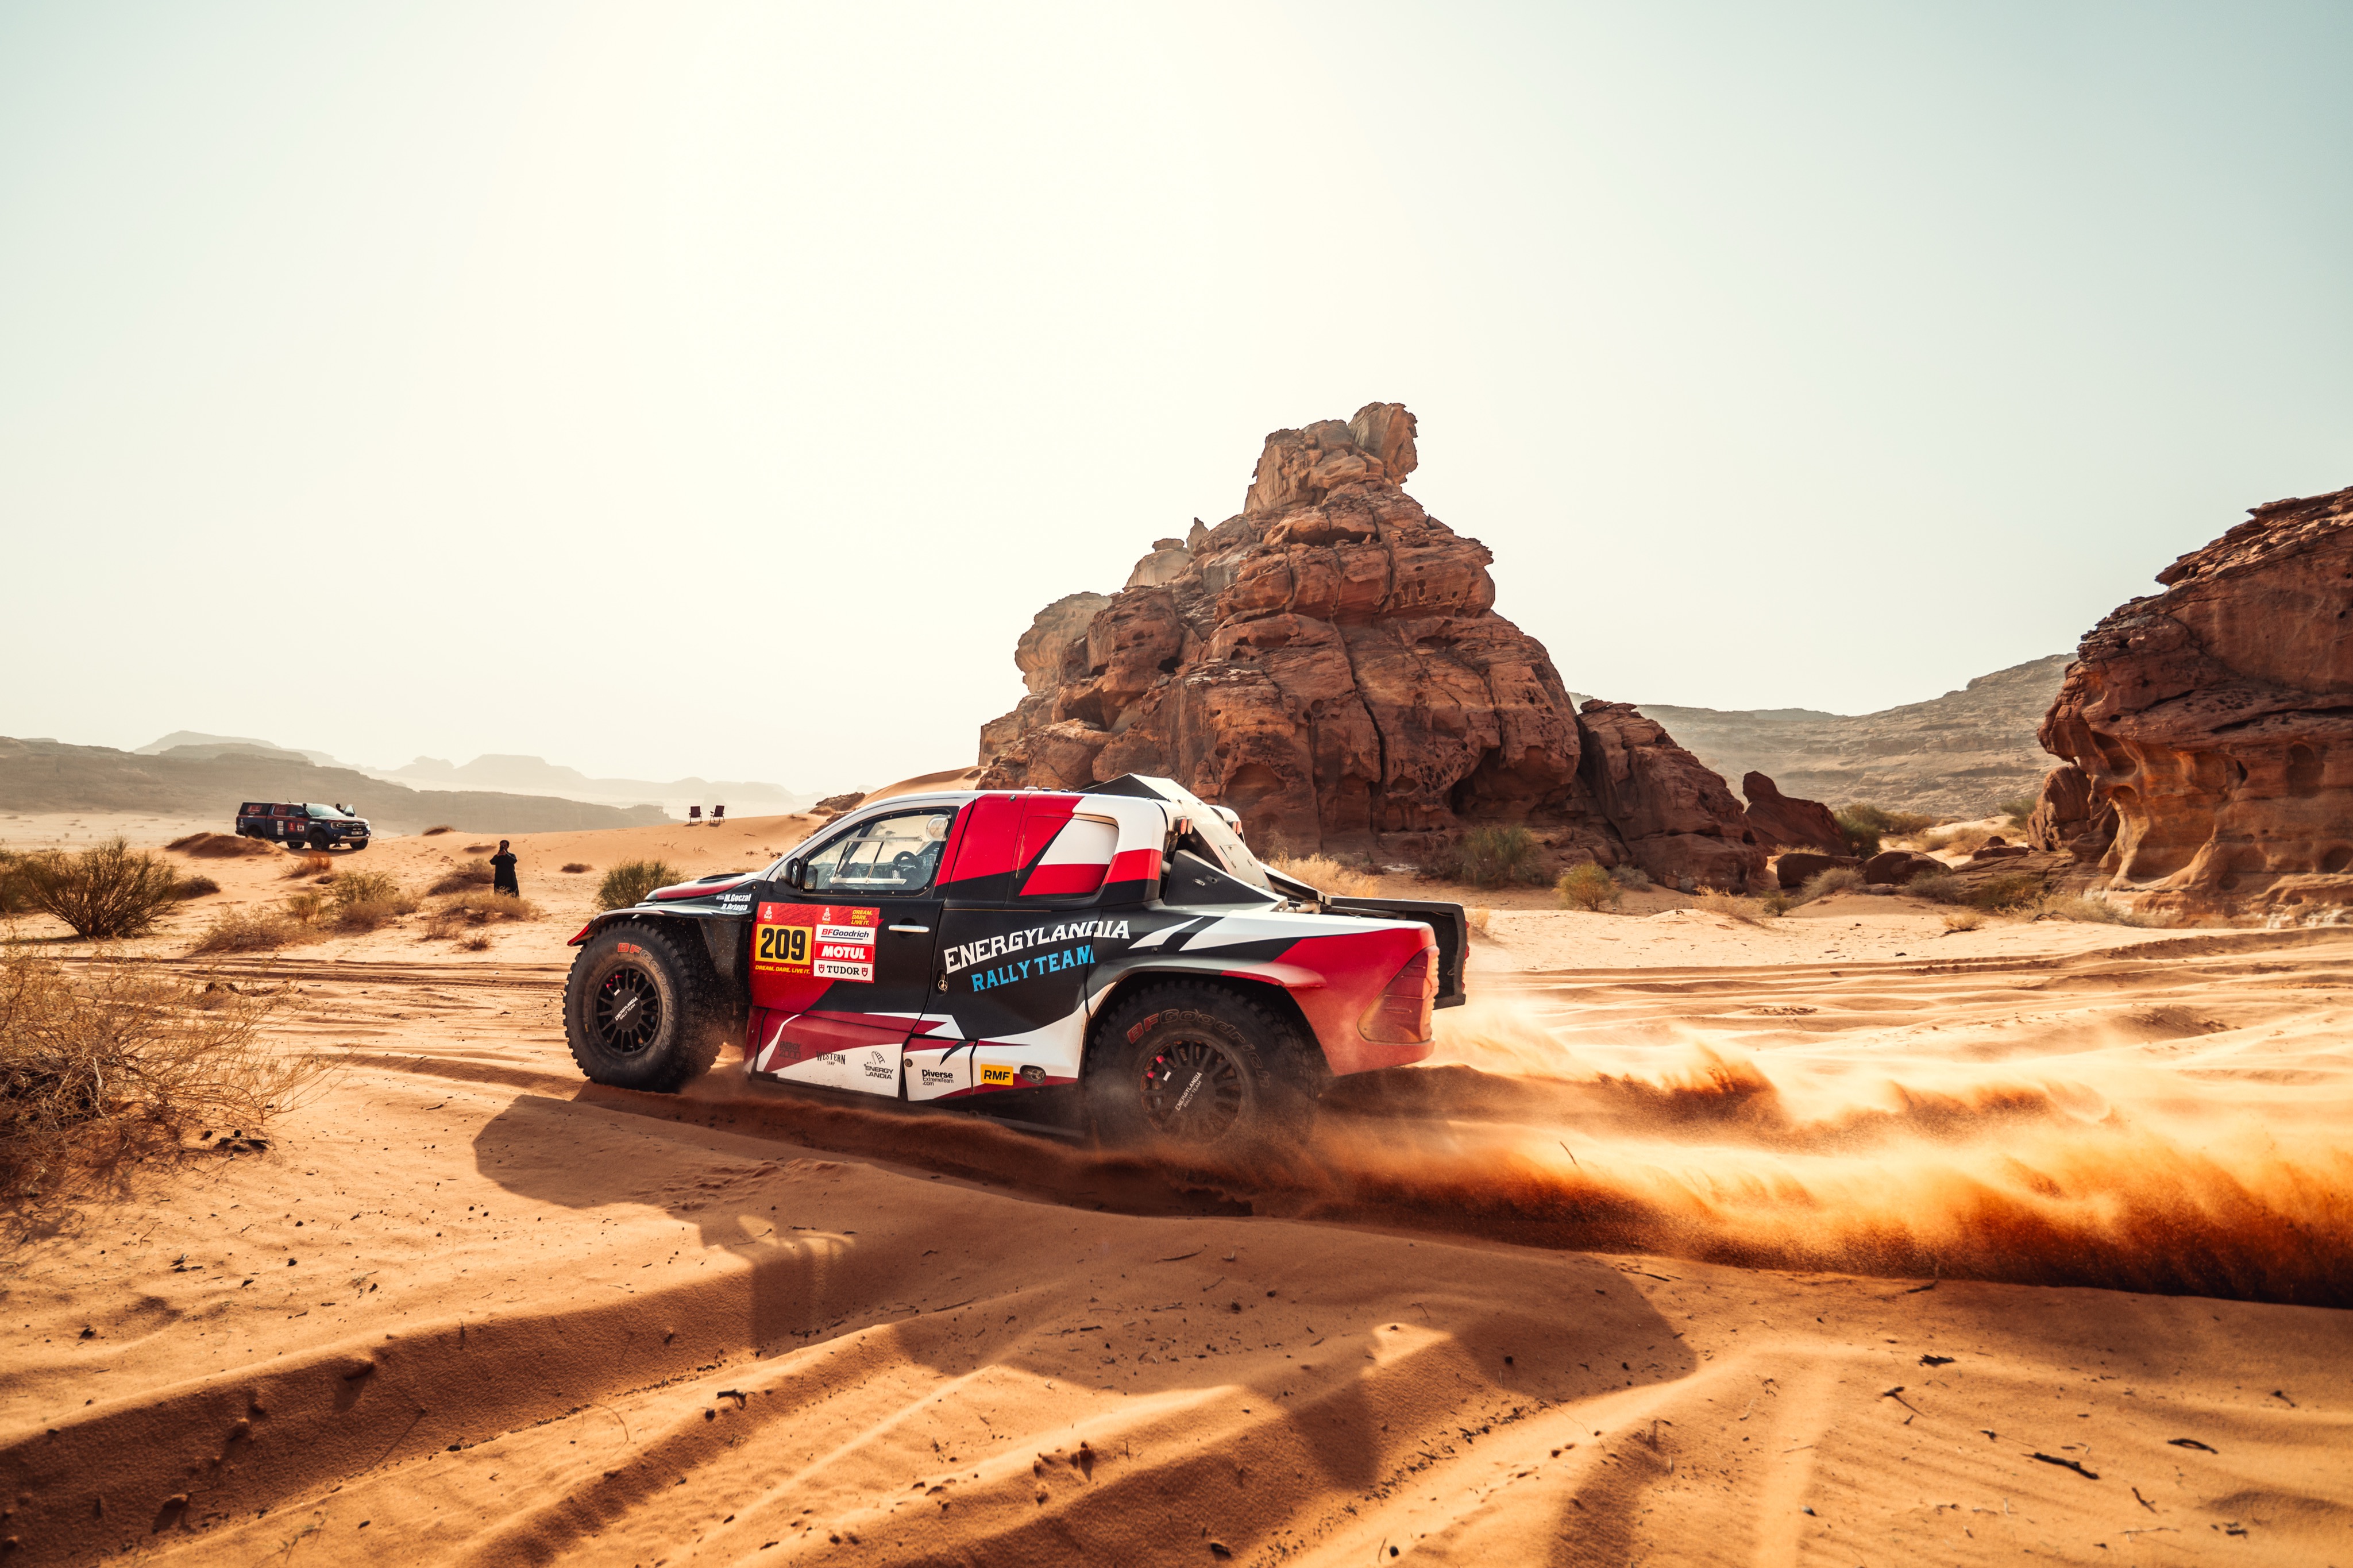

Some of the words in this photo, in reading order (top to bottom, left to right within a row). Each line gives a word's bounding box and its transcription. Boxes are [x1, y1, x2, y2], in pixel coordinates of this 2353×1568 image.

[821, 929, 869, 938] BFGoodrich
[761, 928, 805, 961] 209
[944, 921, 1130, 974] ENERGYLANDIA
[821, 945, 866, 960] MOTUL
[827, 965, 859, 975] TUDOR
[971, 960, 1031, 992] RALLY
[1035, 945, 1096, 975] TEAM
[618, 943, 674, 1050] BFGoodrich
[627, 1003, 635, 1012] TEAM
[1127, 1009, 1270, 1088] BFGoodrich
[816, 1051, 846, 1065] WESTERN
[865, 1065, 894, 1074] ENERGY
[865, 1071, 892, 1080] LANDIA
[921, 1069, 953, 1079] Diverse
[983, 1069, 1010, 1080] RMF
[1175, 1072, 1202, 1111] ENERGYLANDIA
[1183, 1092, 1193, 1107] RALLY
[1191, 1080, 1202, 1094] TEAM
